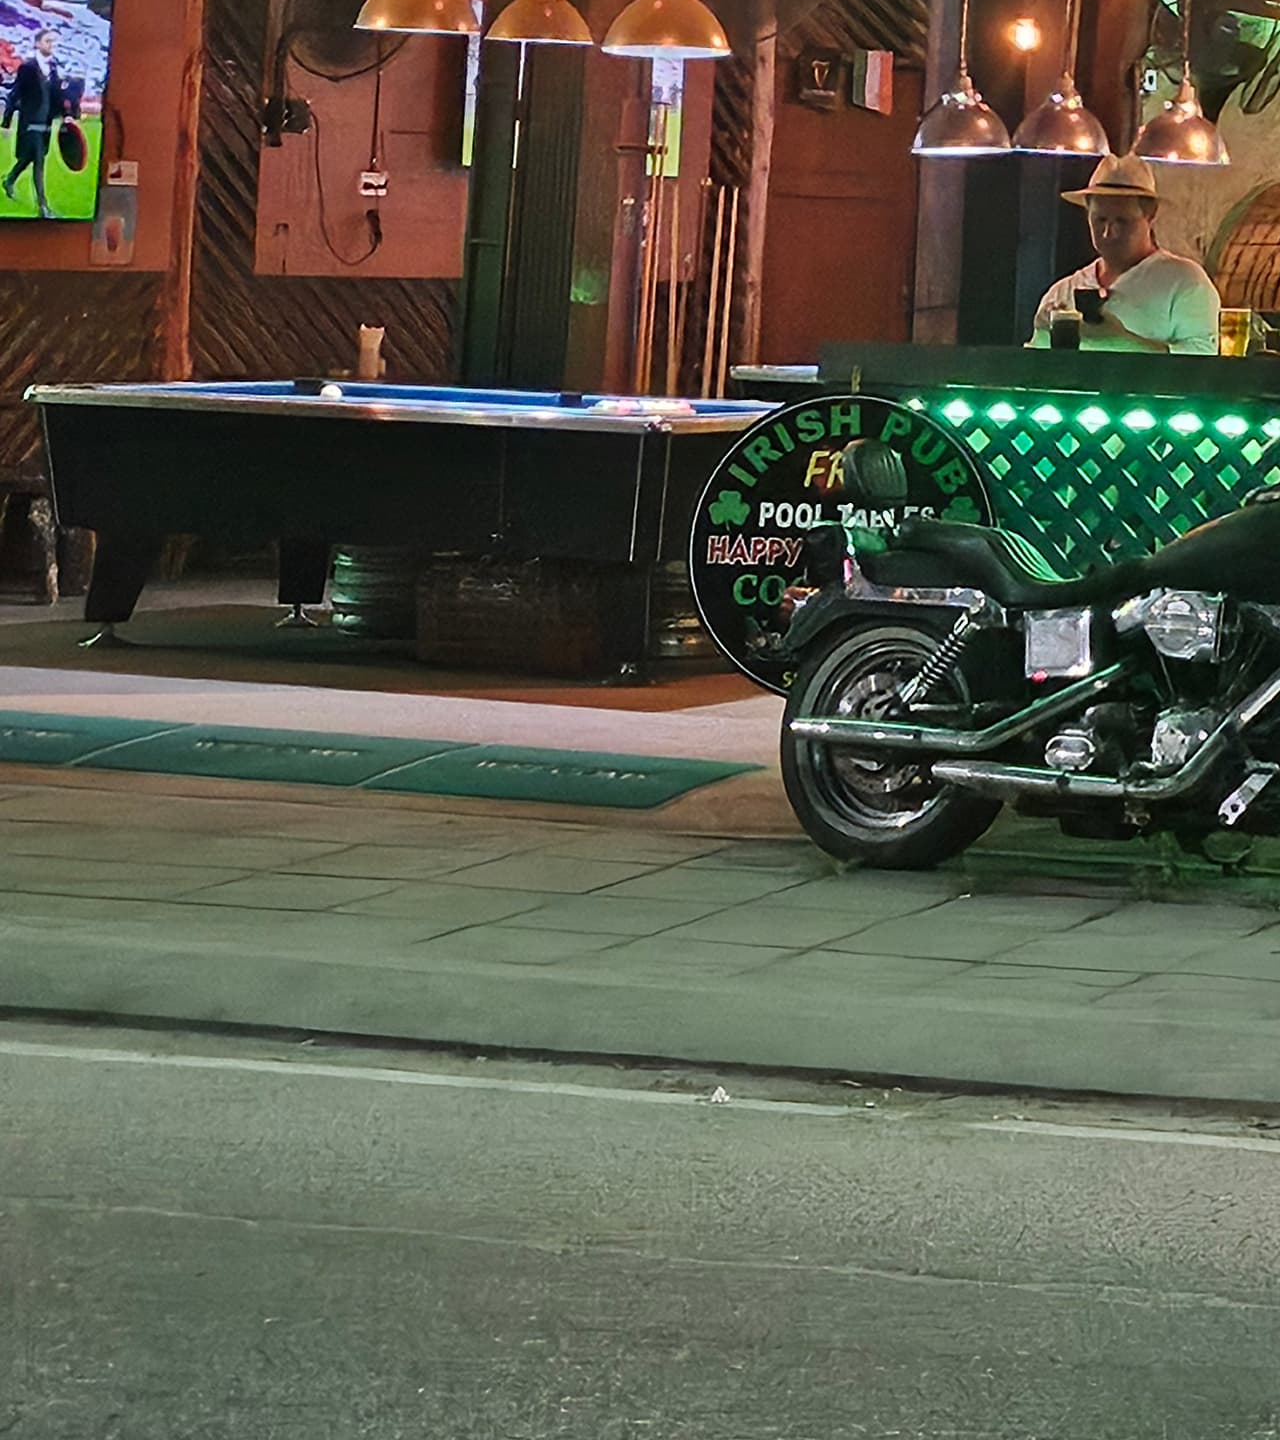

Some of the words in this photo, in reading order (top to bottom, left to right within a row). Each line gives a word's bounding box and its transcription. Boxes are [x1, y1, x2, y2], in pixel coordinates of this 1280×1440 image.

[728, 404, 860, 487] IRISH
[880, 411, 968, 494] PUB
[758, 502, 822, 530] POOL
[706, 534, 803, 567] HAPPY
